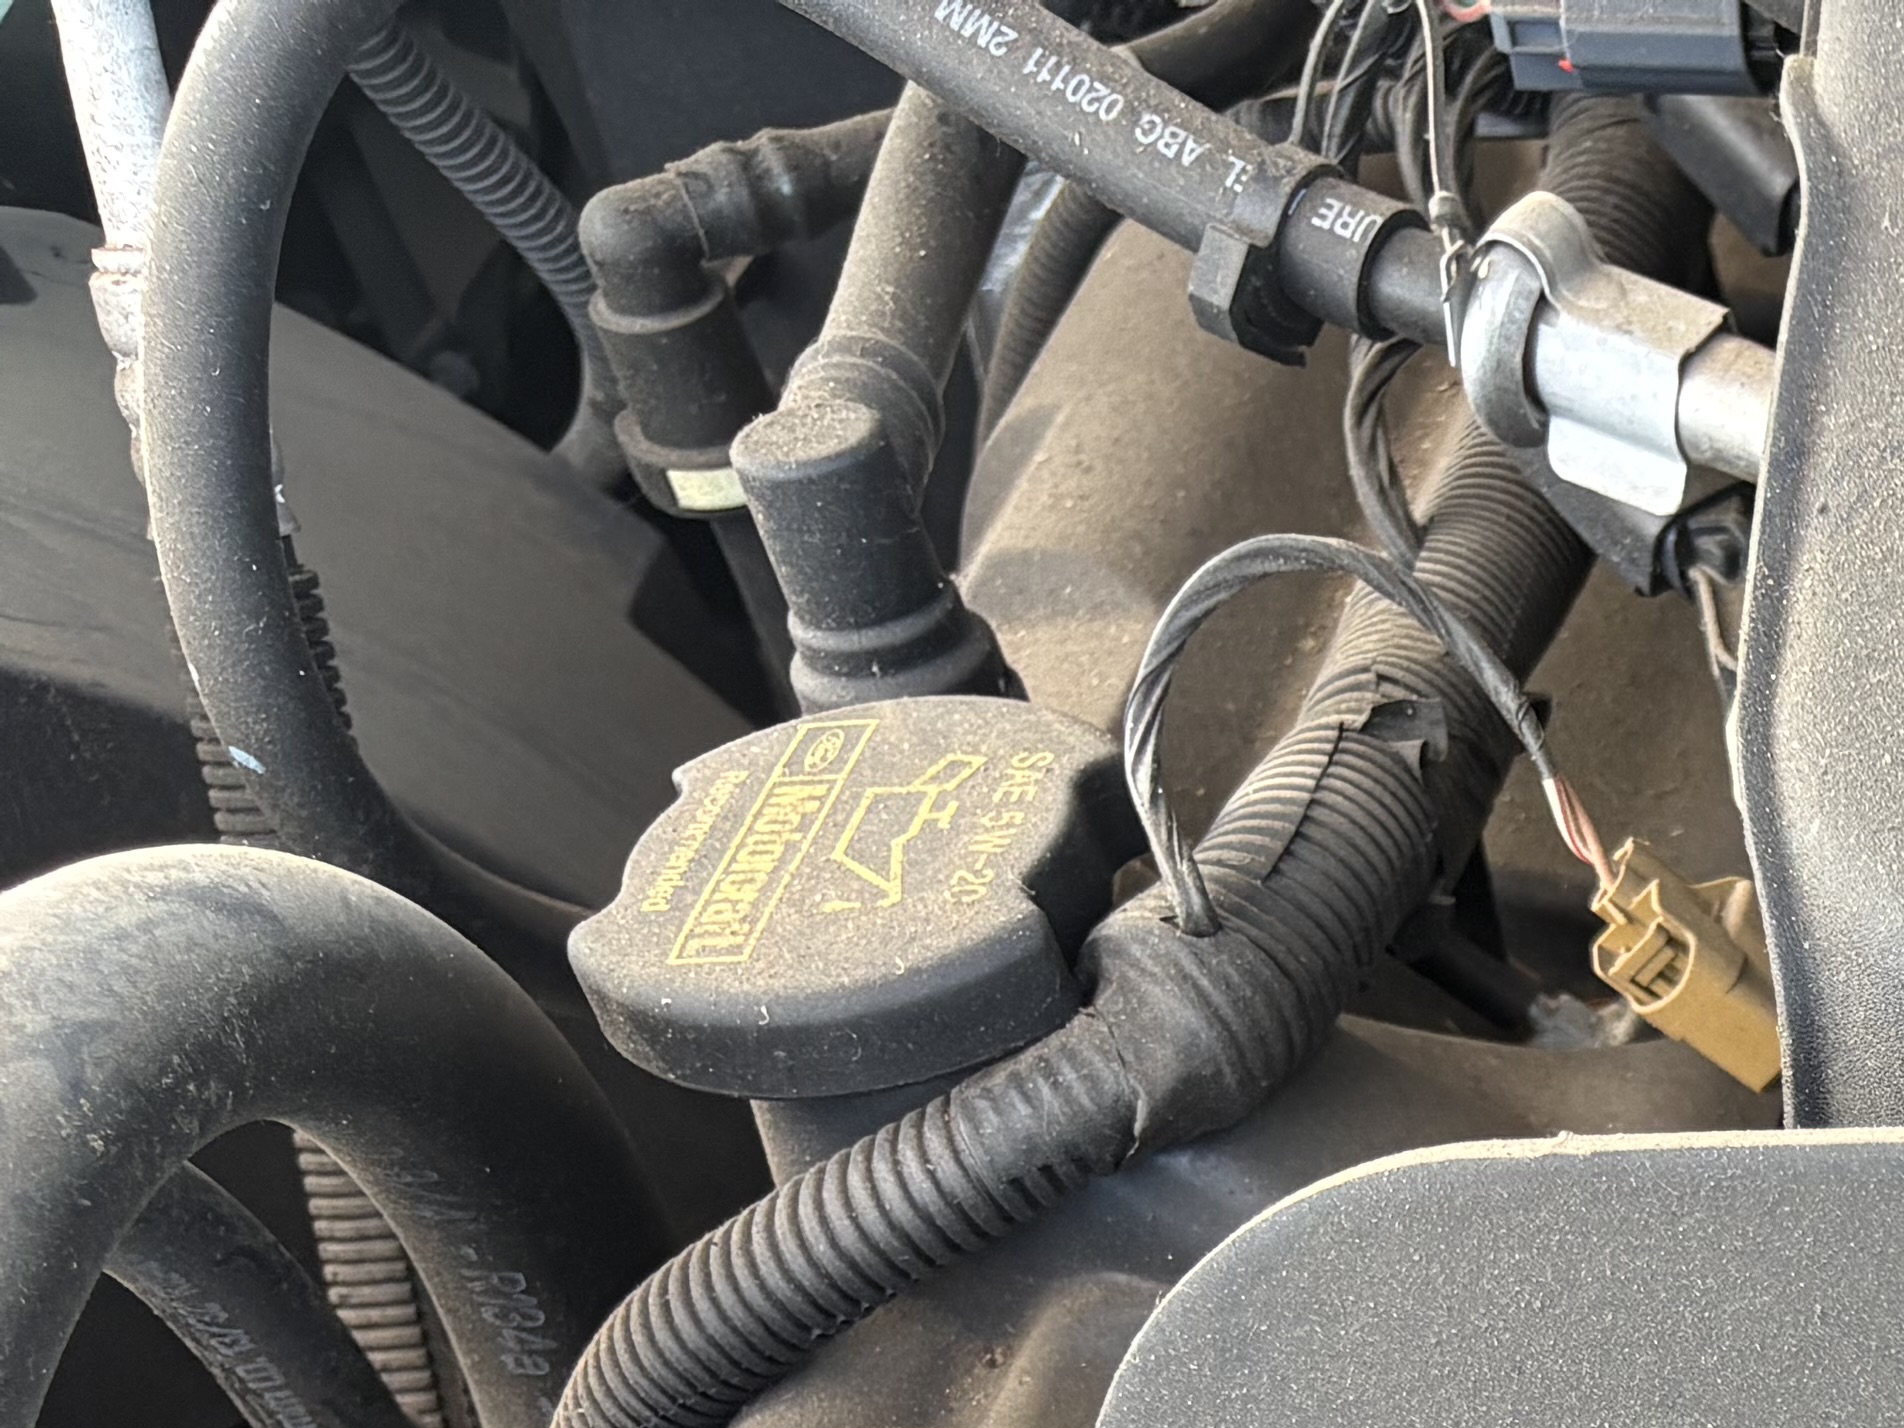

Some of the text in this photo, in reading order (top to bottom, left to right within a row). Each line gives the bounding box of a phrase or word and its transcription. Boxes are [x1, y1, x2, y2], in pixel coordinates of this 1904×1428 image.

[1023, 45, 1123, 122] 020111
[1135, 112, 1205, 177] ABG
[640, 770, 749, 913] Recommended
[943, 750, 1054, 903] SAE 5W-20
